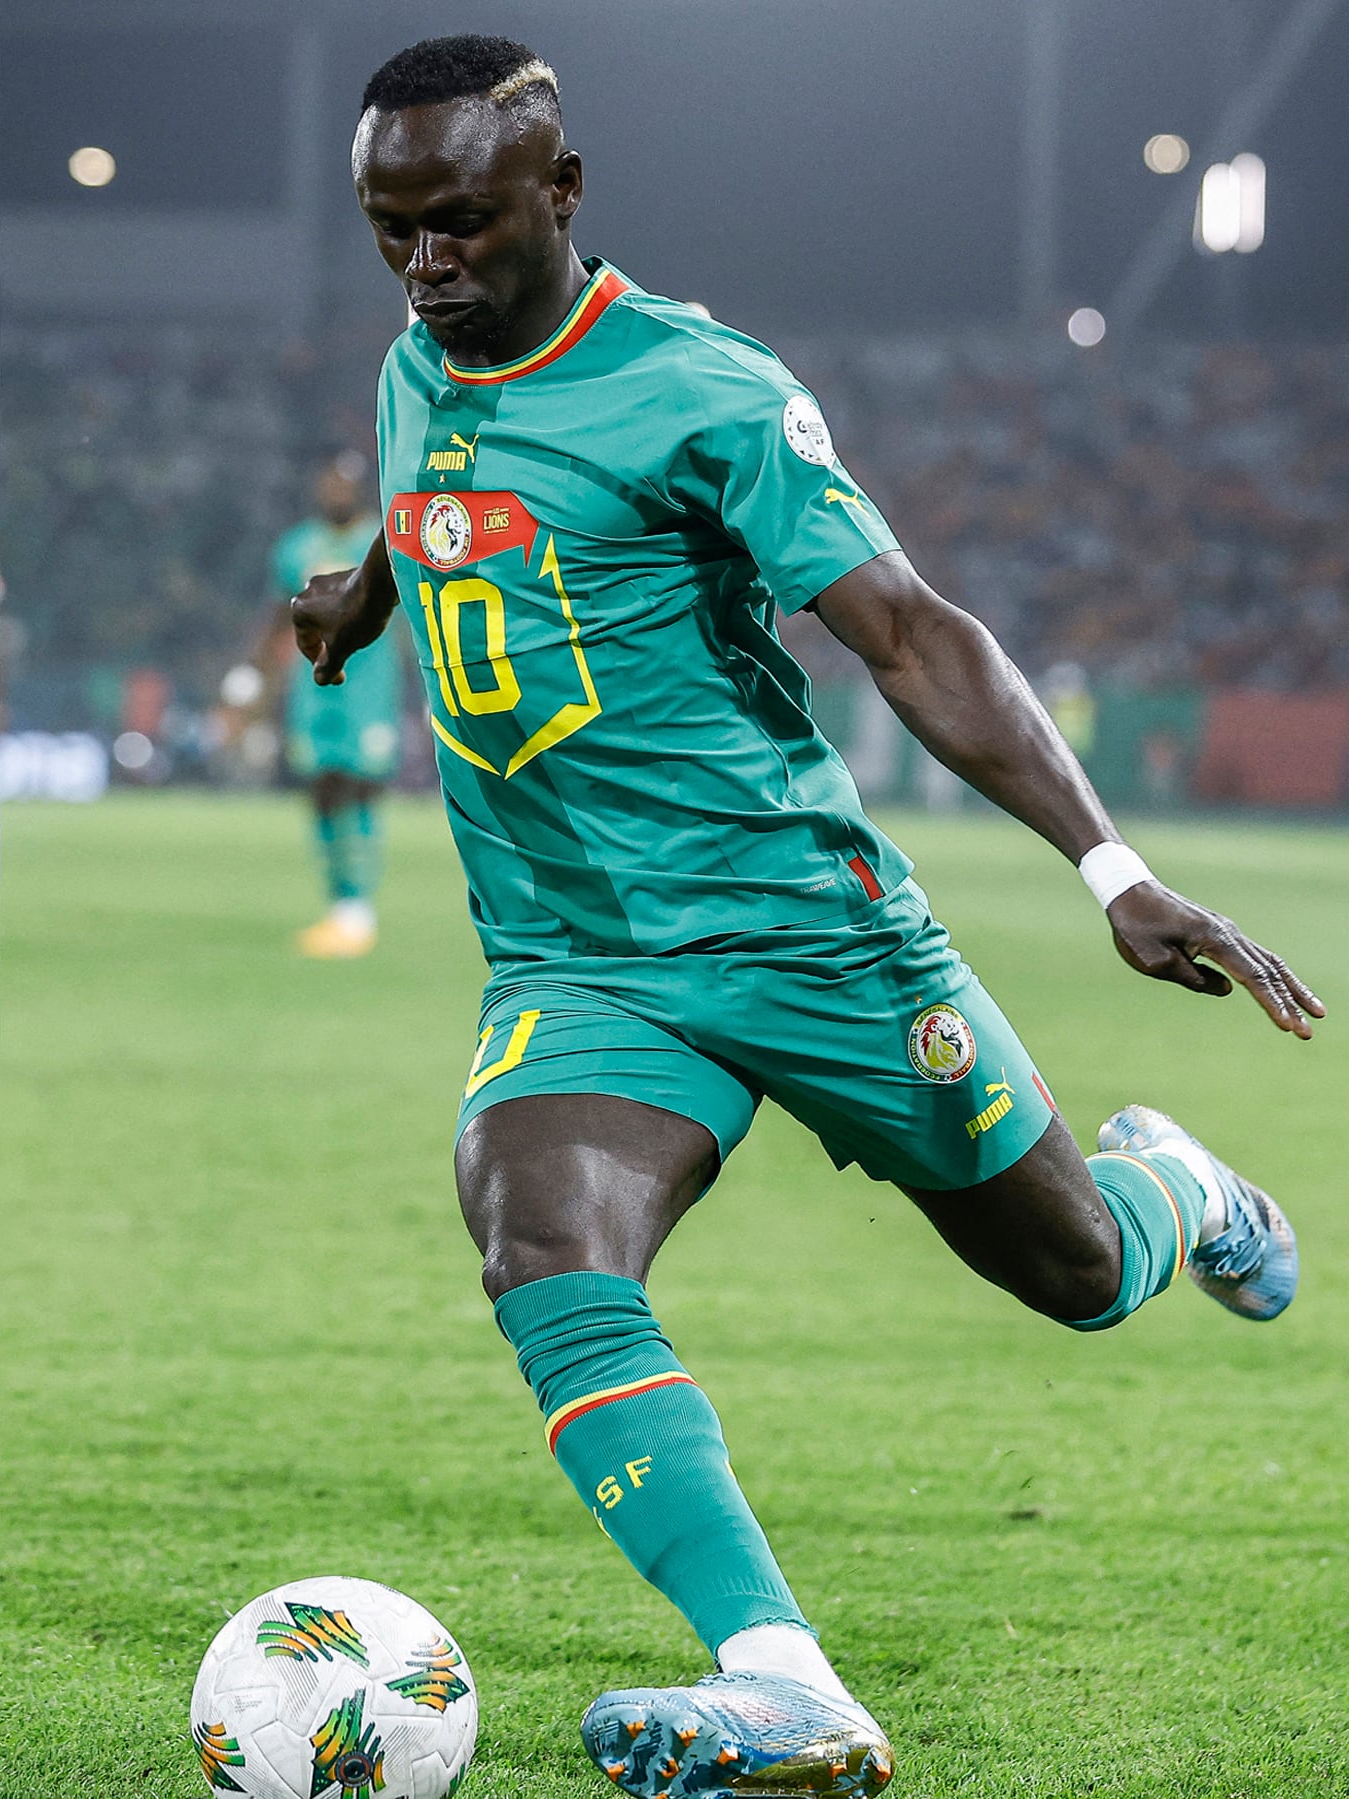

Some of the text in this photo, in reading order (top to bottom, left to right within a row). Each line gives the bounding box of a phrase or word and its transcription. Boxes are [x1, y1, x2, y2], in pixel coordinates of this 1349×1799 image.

[426, 451, 467, 471] PUMA
[483, 513, 510, 530] LIONS
[418, 578, 523, 717] 10
[964, 1091, 1014, 1140] PUMA
